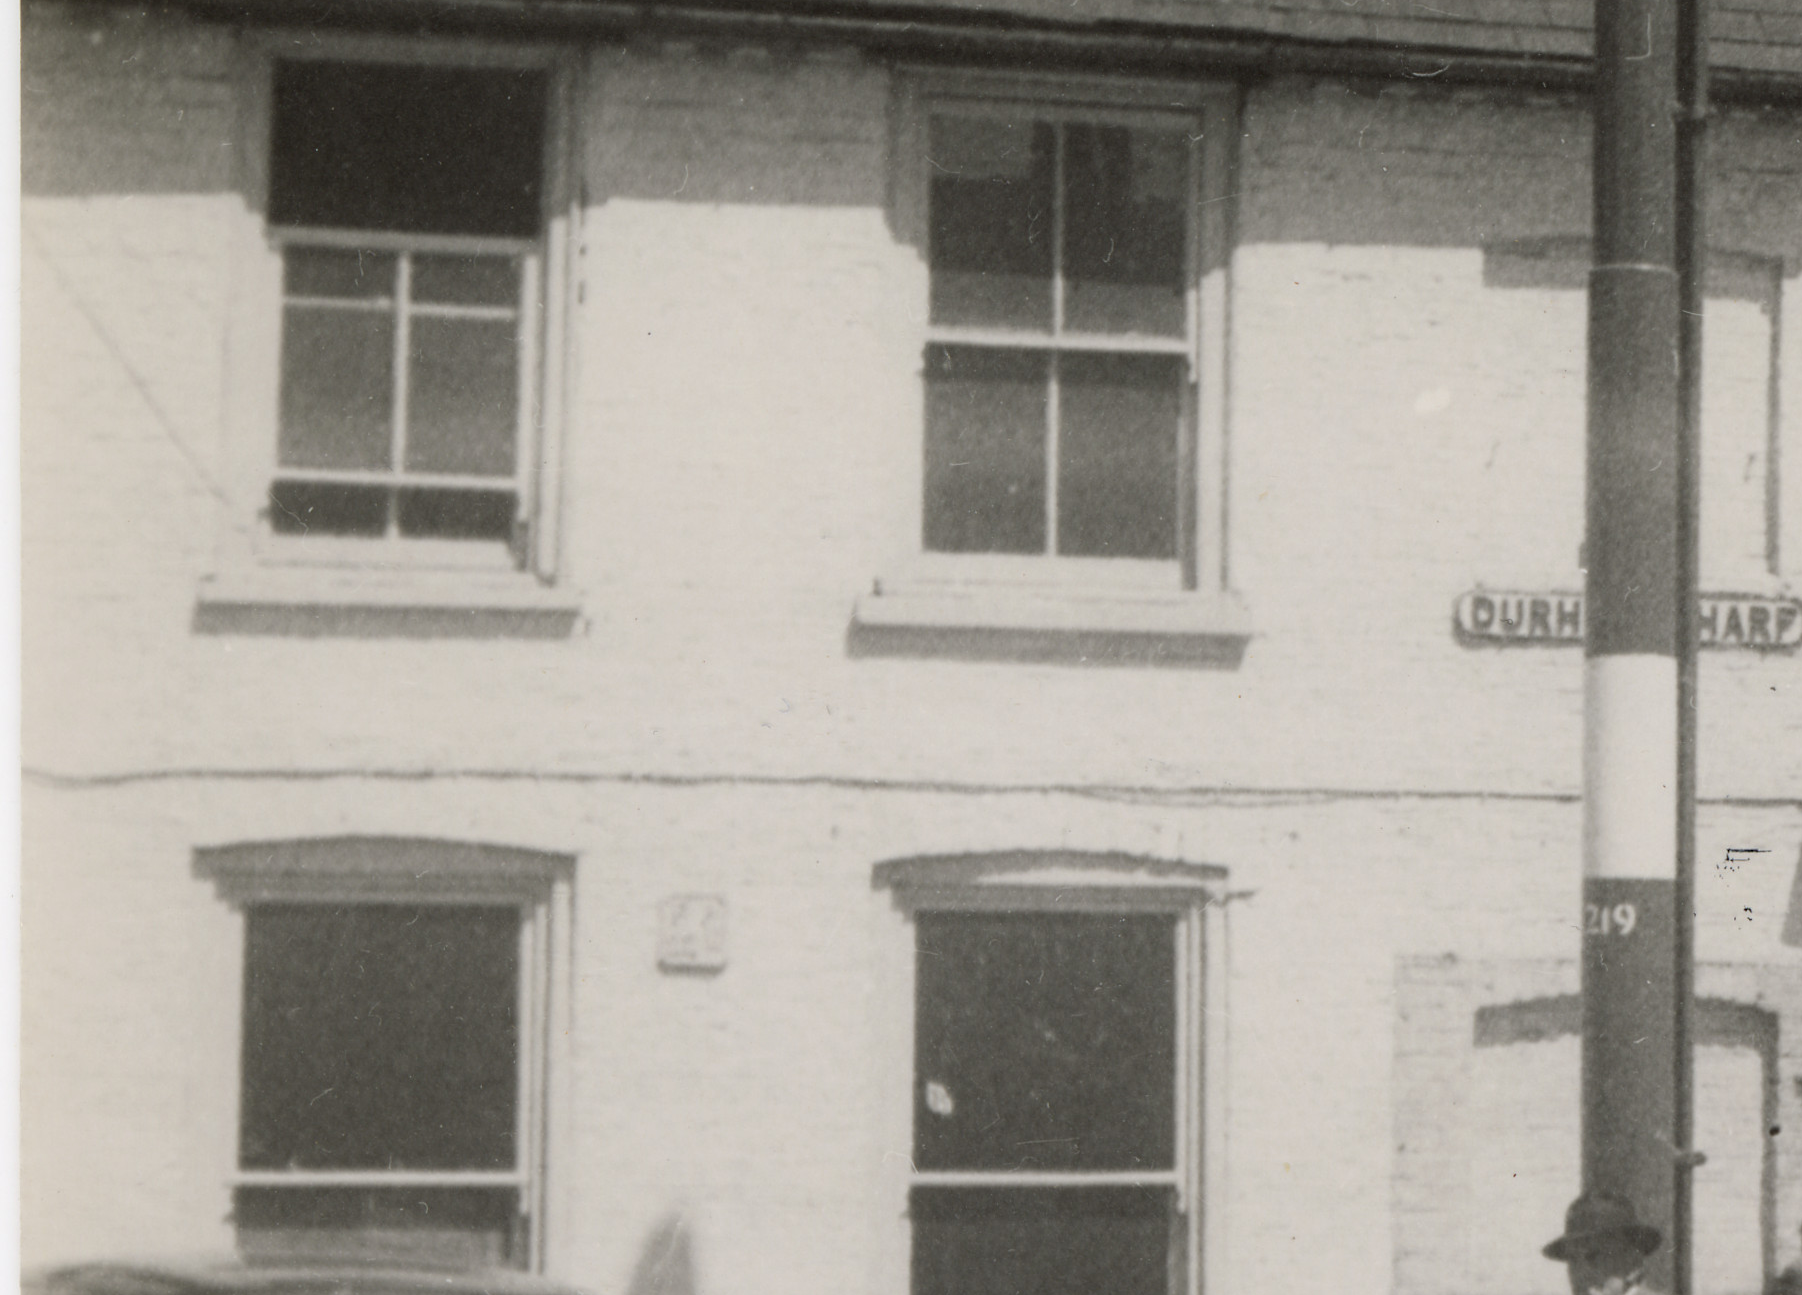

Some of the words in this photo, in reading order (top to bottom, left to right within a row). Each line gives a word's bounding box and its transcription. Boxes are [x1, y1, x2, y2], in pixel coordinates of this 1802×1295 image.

[1472, 595, 1580, 637] DURH
[1698, 605, 1799, 644] HARF
[1583, 903, 1637, 936] 219
